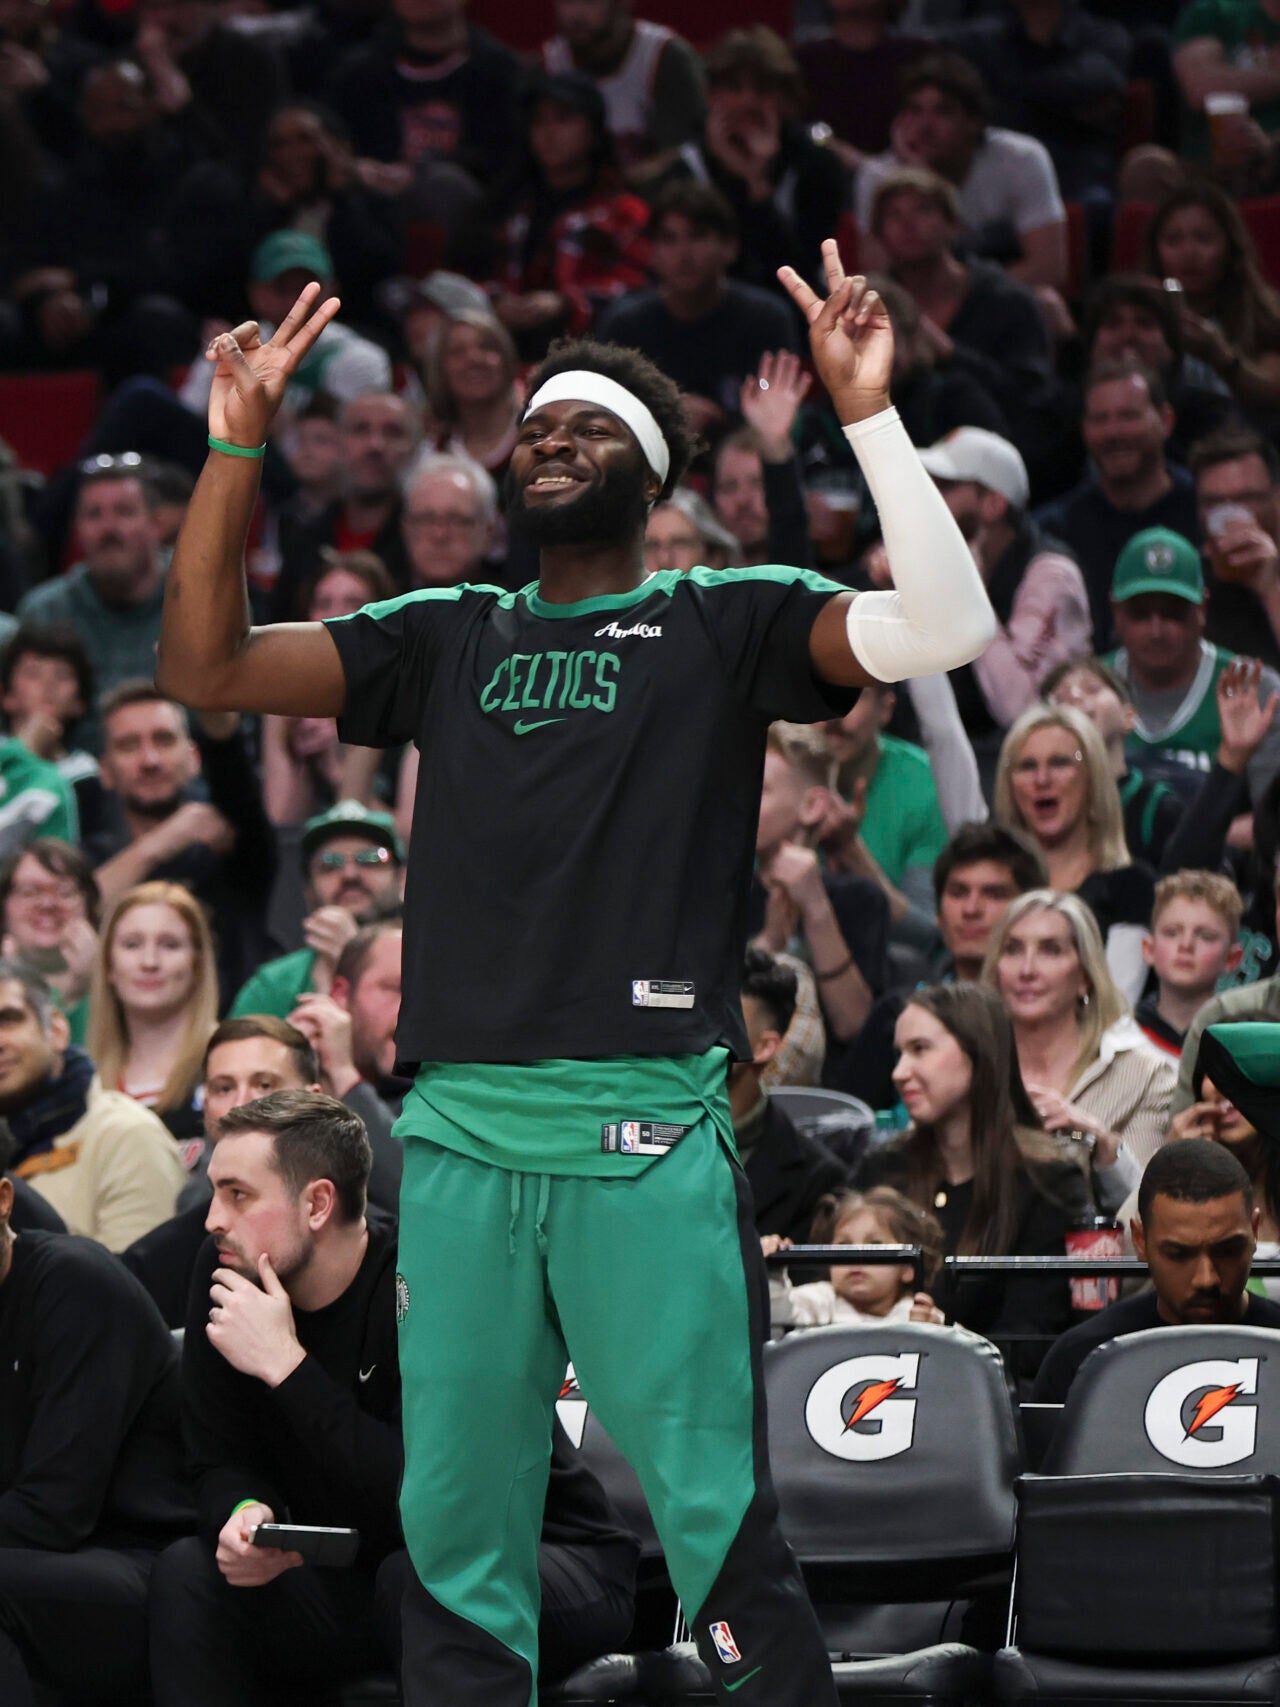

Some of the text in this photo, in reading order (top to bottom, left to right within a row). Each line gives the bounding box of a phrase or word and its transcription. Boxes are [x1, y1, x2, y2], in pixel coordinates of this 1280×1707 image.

[480, 650, 620, 714] CELTICS
[804, 1352, 920, 1462] G
[1143, 1357, 1259, 1469] G
